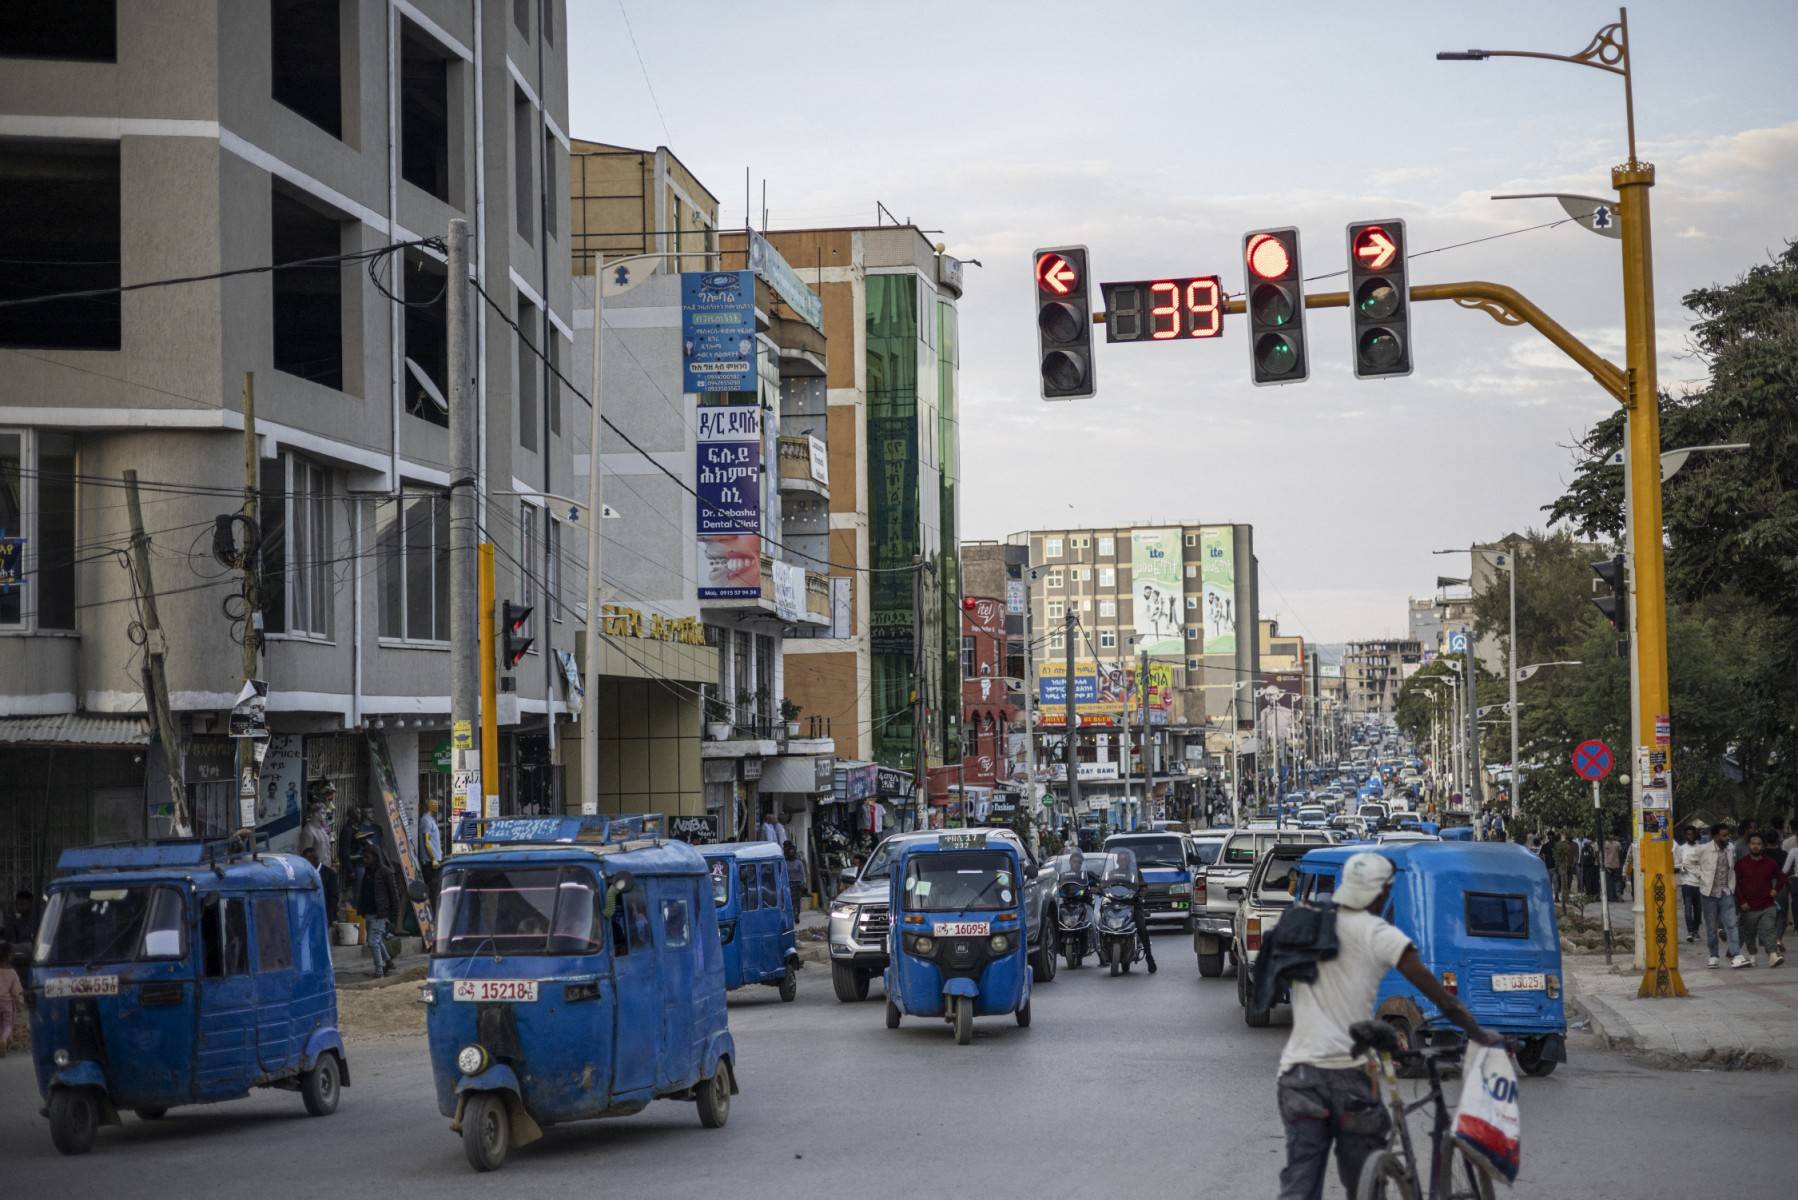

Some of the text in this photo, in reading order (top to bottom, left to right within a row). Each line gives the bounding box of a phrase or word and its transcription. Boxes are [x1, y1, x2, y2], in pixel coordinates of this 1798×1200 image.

[1153, 281, 1217, 338] 39
[700, 465, 758, 483] ሕክምና
[702, 508, 756, 517] Dr. Debashu
[703, 520, 733, 529] Dental
[977, 603, 993, 616] itel
[954, 924, 984, 935] 16095
[481, 983, 525, 999] 15218
